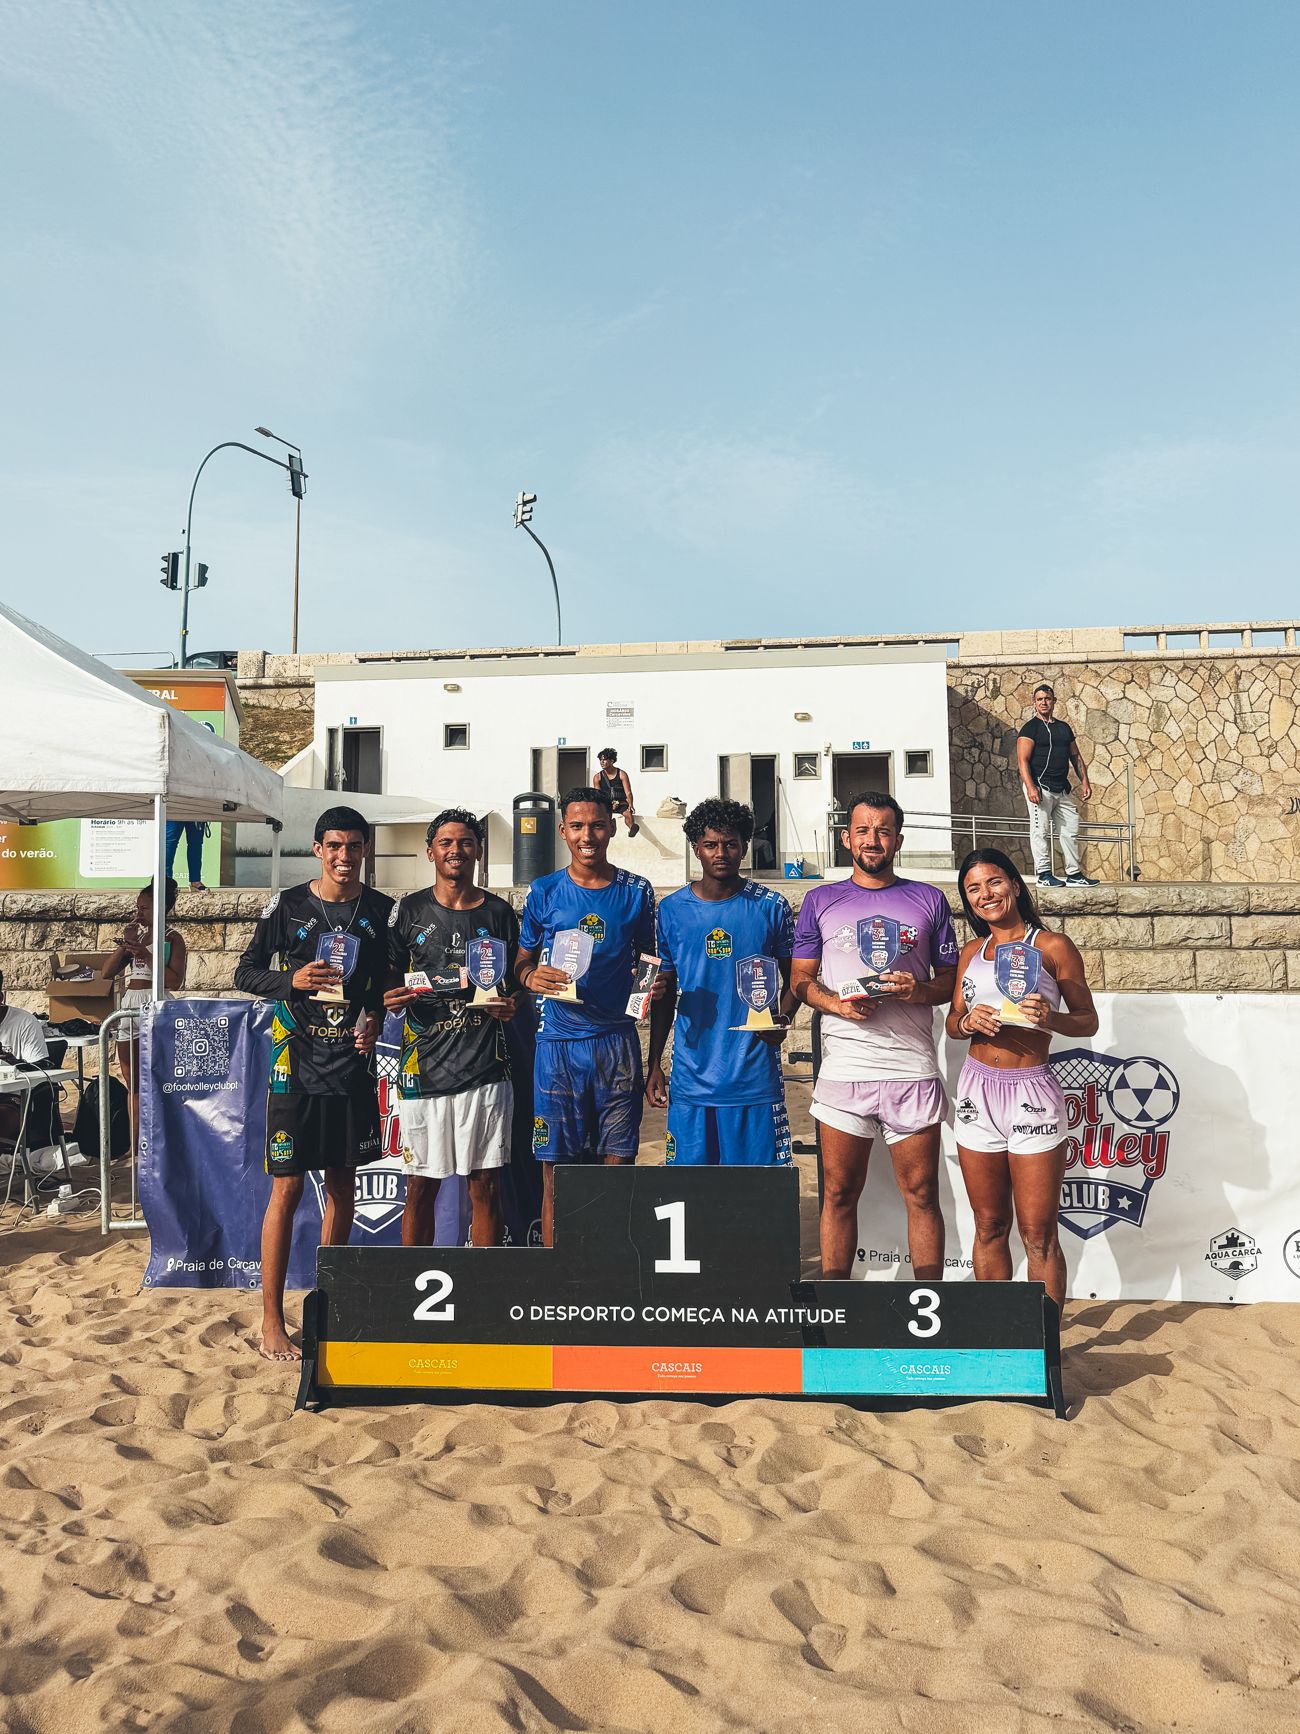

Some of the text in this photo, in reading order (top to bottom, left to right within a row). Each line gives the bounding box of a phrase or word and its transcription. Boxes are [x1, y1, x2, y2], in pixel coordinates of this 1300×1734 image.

[1, 847, 57, 858] do verão.
[303, 917, 318, 931] IWS
[434, 1014, 482, 1032] TOBIAS
[162, 1080, 238, 1094] @footvolleyclubpt
[354, 1174, 398, 1201] CLUB
[1060, 1183, 1110, 1210] CLUB
[653, 1200, 701, 1274] 1
[869, 1250, 900, 1263] Praia
[1204, 1247, 1263, 1260] AQUA CARCA
[175, 1257, 262, 1272] Praia de Carcav
[413, 1269, 455, 1321] 2
[509, 1305, 847, 1325] O DESPORTO COMEÇA NA ATITUDE
[907, 1288, 942, 1338] 3
[408, 1358, 458, 1369] CASCAIS
[651, 1362, 703, 1373] CASCAIS
[899, 1364, 951, 1375] CASCAIS
